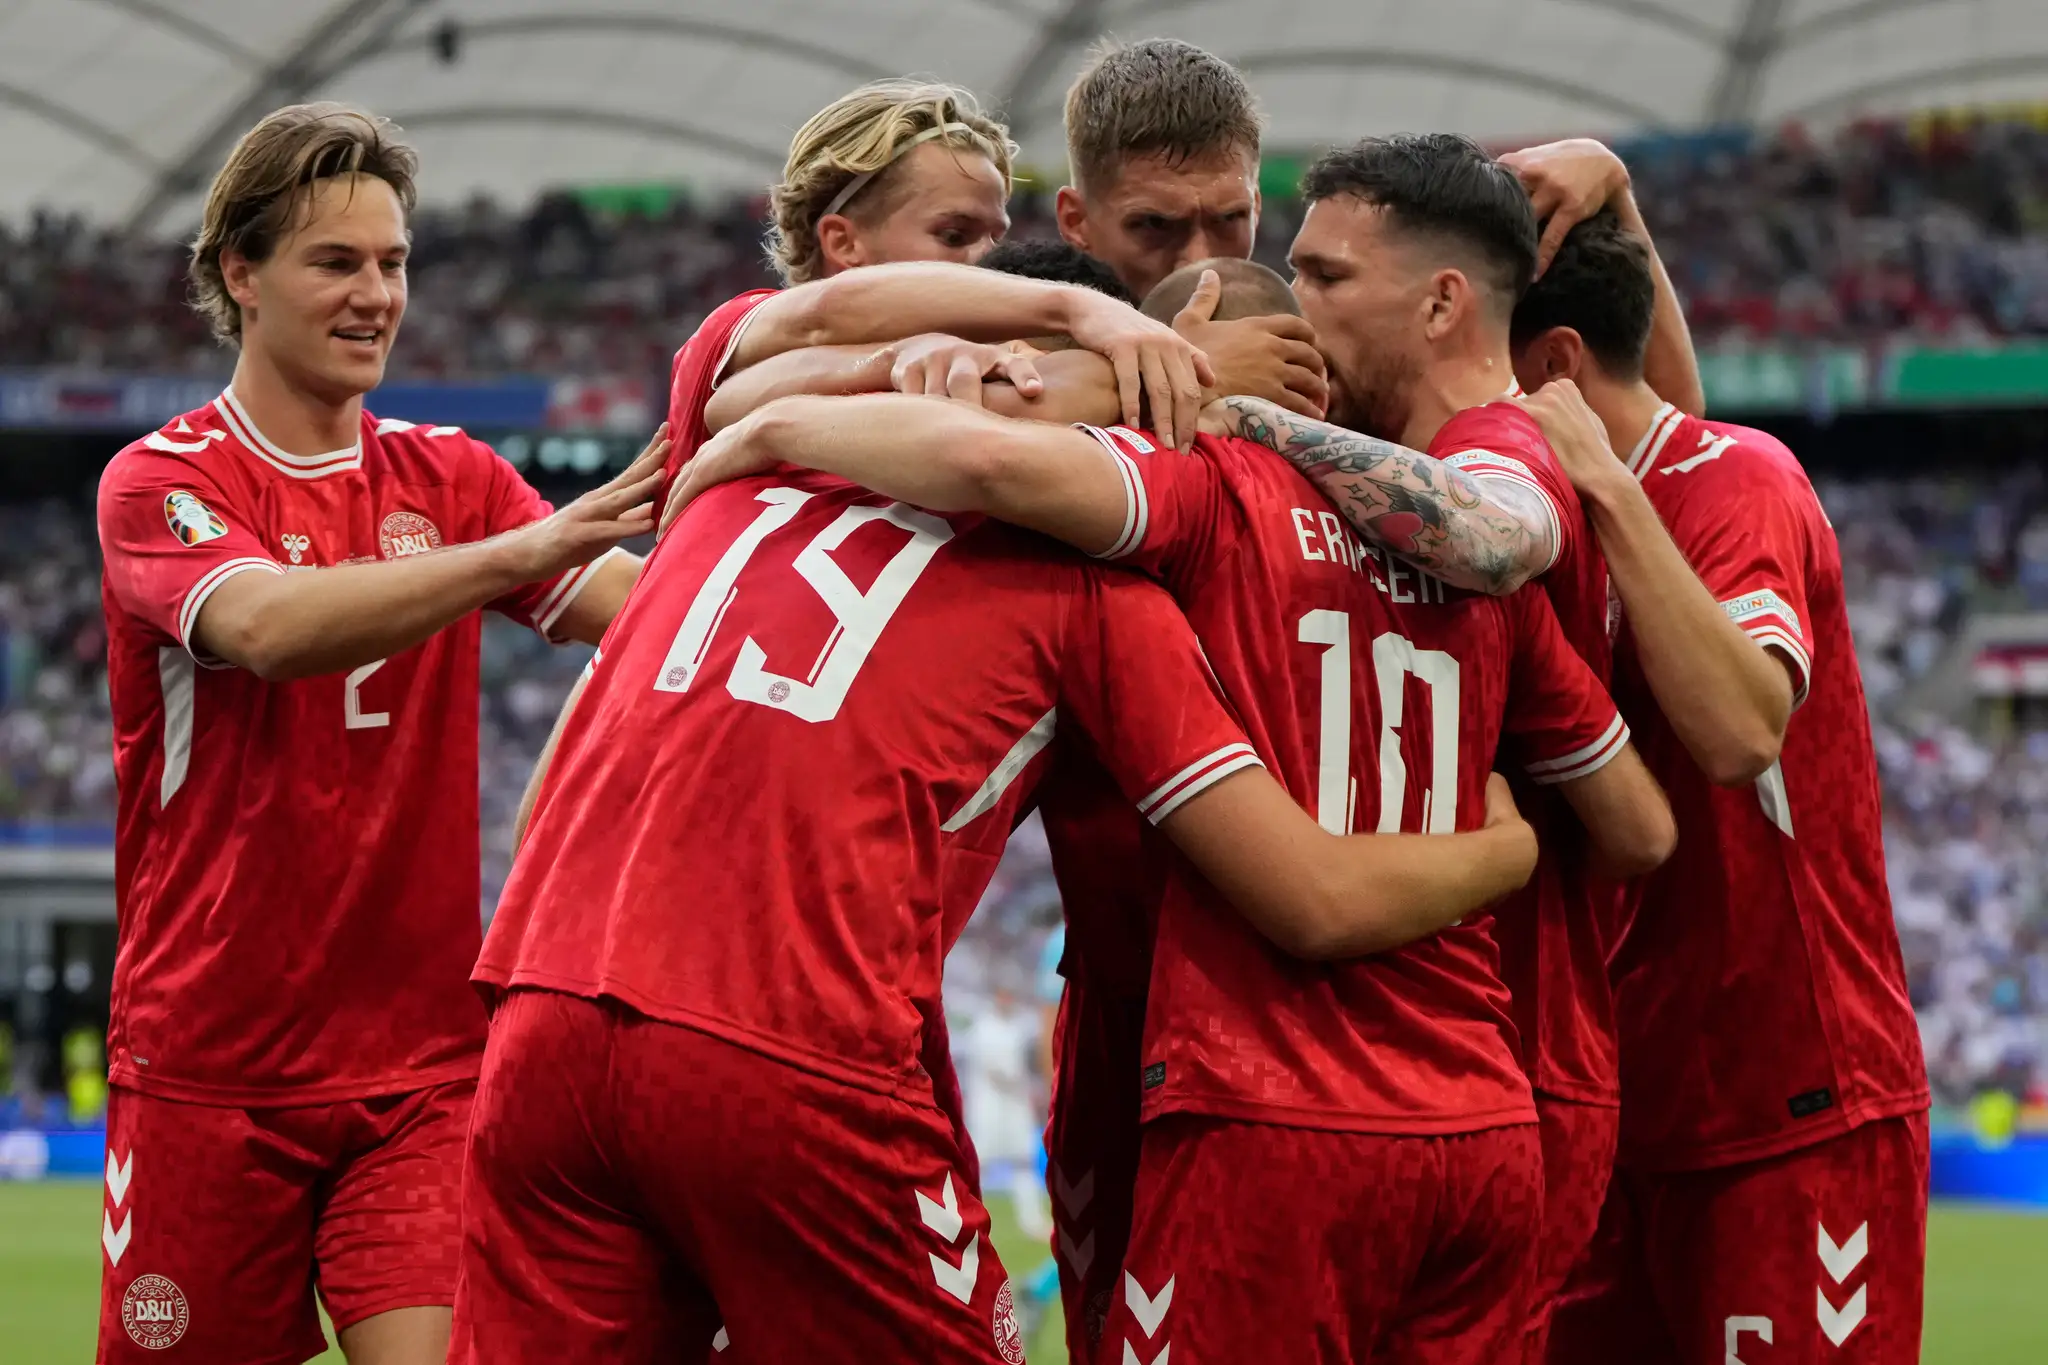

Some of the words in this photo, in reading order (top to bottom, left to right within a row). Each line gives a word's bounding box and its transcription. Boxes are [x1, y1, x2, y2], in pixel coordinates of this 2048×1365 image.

[391, 533, 431, 556] DBU
[652, 486, 956, 723] 19
[1298, 609, 1460, 835] 10
[124, 1296, 141, 1339] DANSK
[172, 1297, 187, 1337] UNION
[135, 1299, 174, 1322] DBU
[1003, 1309, 1018, 1340] DB
[143, 1337, 171, 1347] 1889
